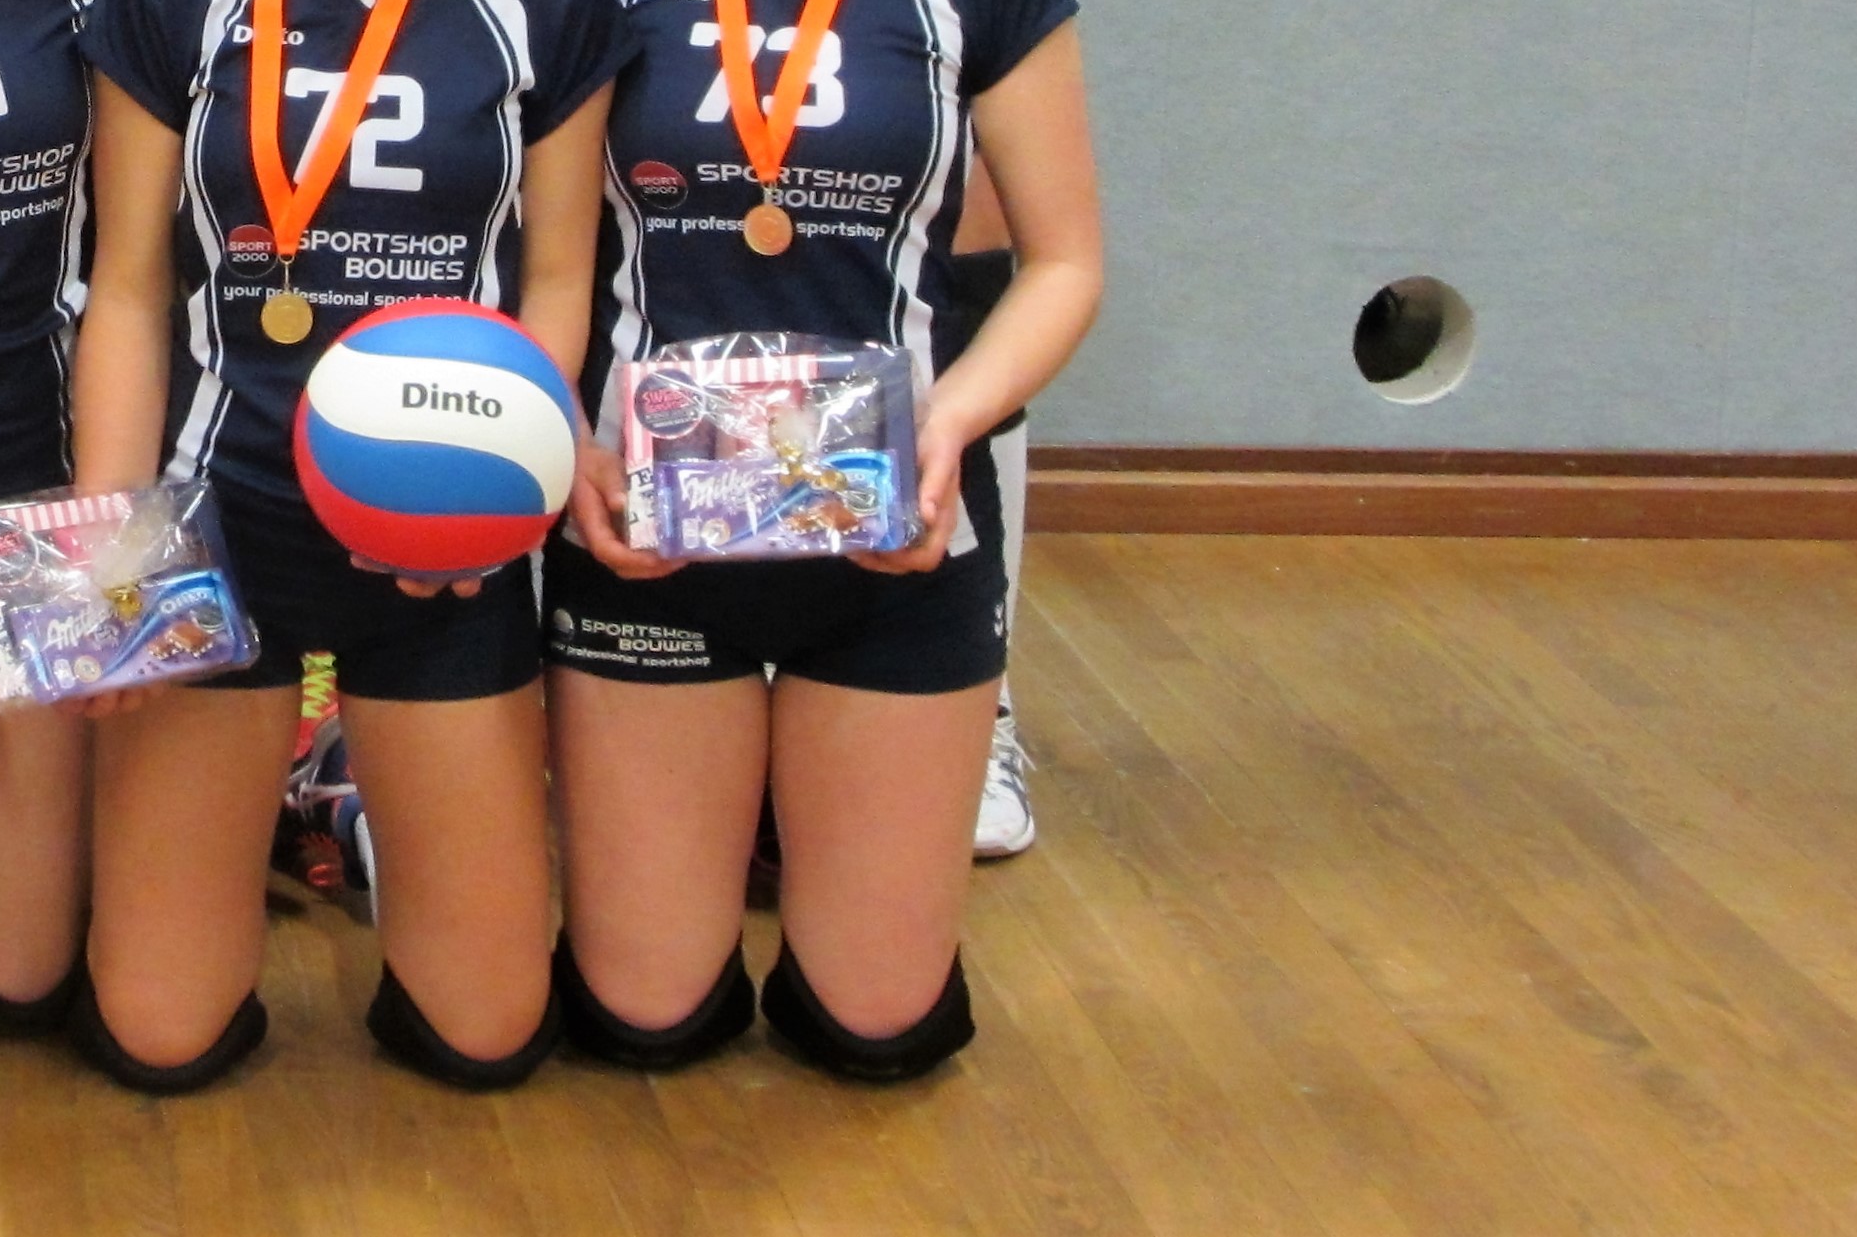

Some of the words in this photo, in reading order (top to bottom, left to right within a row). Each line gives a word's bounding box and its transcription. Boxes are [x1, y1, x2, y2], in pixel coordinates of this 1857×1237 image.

[689, 21, 845, 128] 73
[284, 66, 425, 192] 72
[646, 216, 677, 232] your
[796, 221, 886, 242] sportshop
[228, 240, 273, 252] SPORT
[298, 229, 468, 256] SPORTSHOP
[231, 251, 269, 263] 2000
[344, 256, 465, 282] BOUWES
[223, 285, 262, 301] your
[401, 382, 503, 419] Dinto
[580, 618, 705, 640] SPORTSHOP
[618, 638, 706, 653] BOUWES
[642, 656, 712, 668] sportshop
